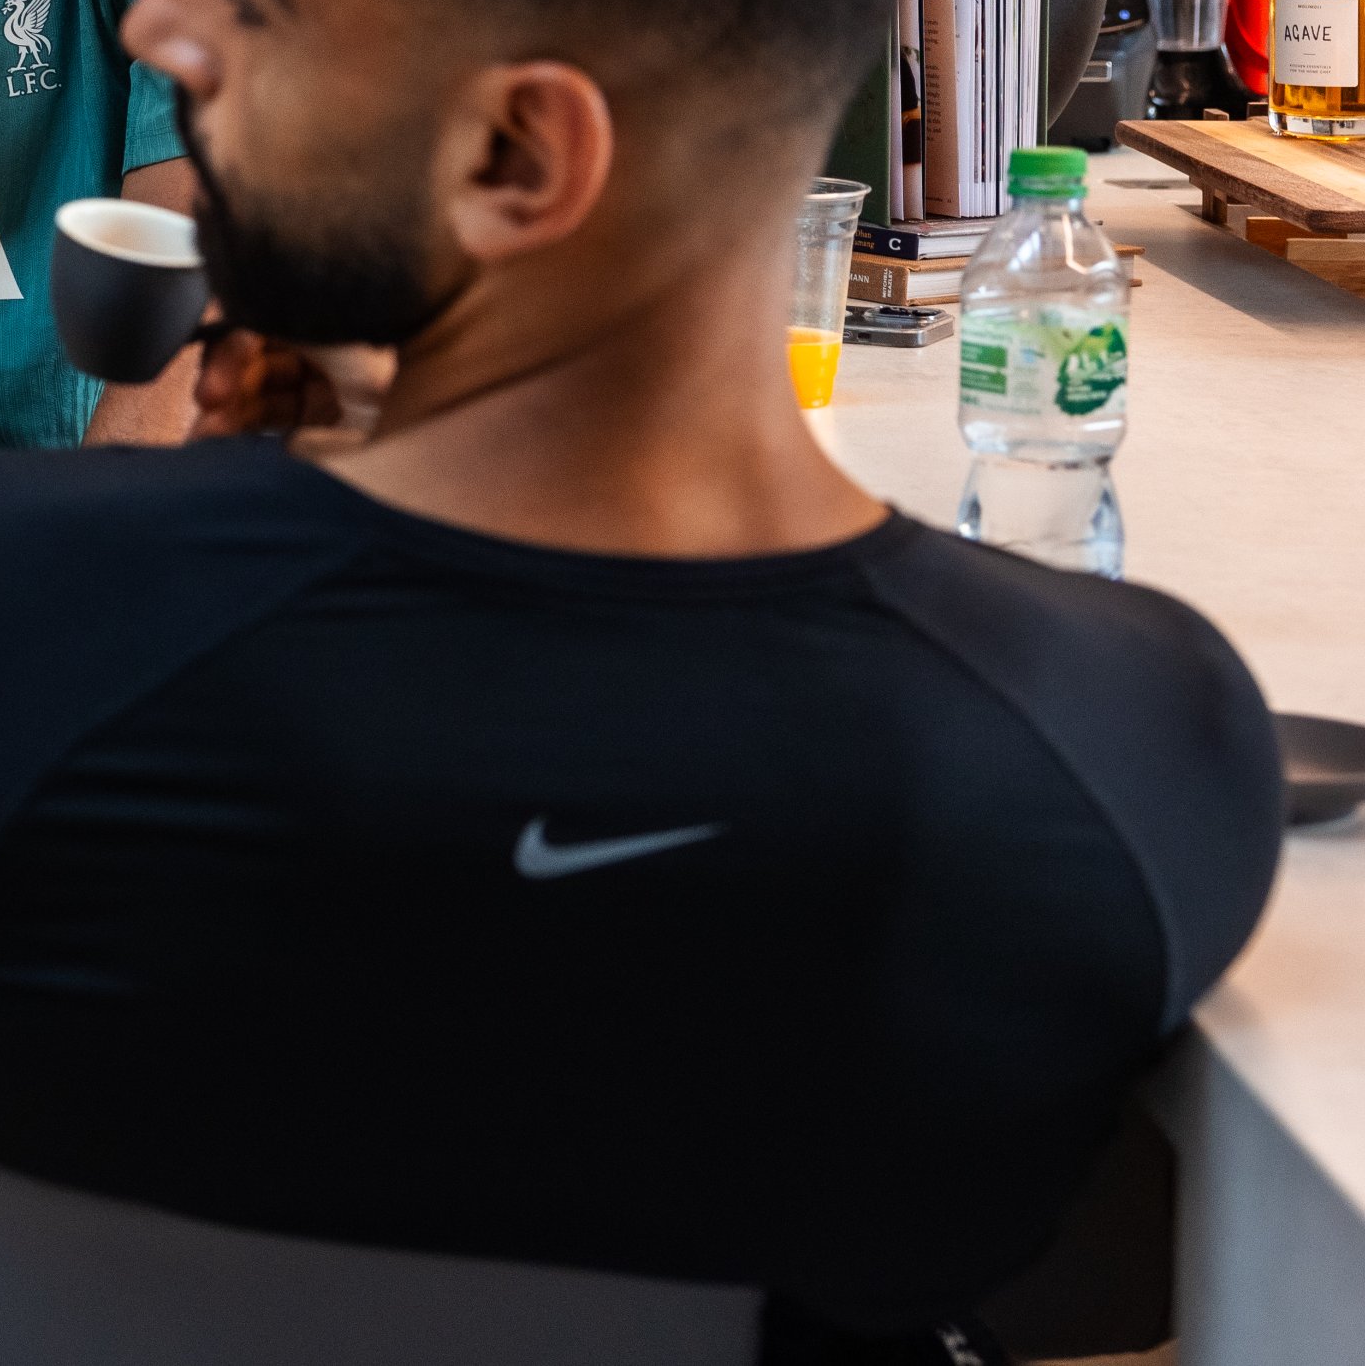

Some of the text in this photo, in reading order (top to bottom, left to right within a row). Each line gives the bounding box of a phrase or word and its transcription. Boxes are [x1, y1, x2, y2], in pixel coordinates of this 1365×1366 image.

[1284, 24, 1332, 42] AGAVE
[6, 68, 62, 97] L.F.C.
[888, 238, 902, 251] C
